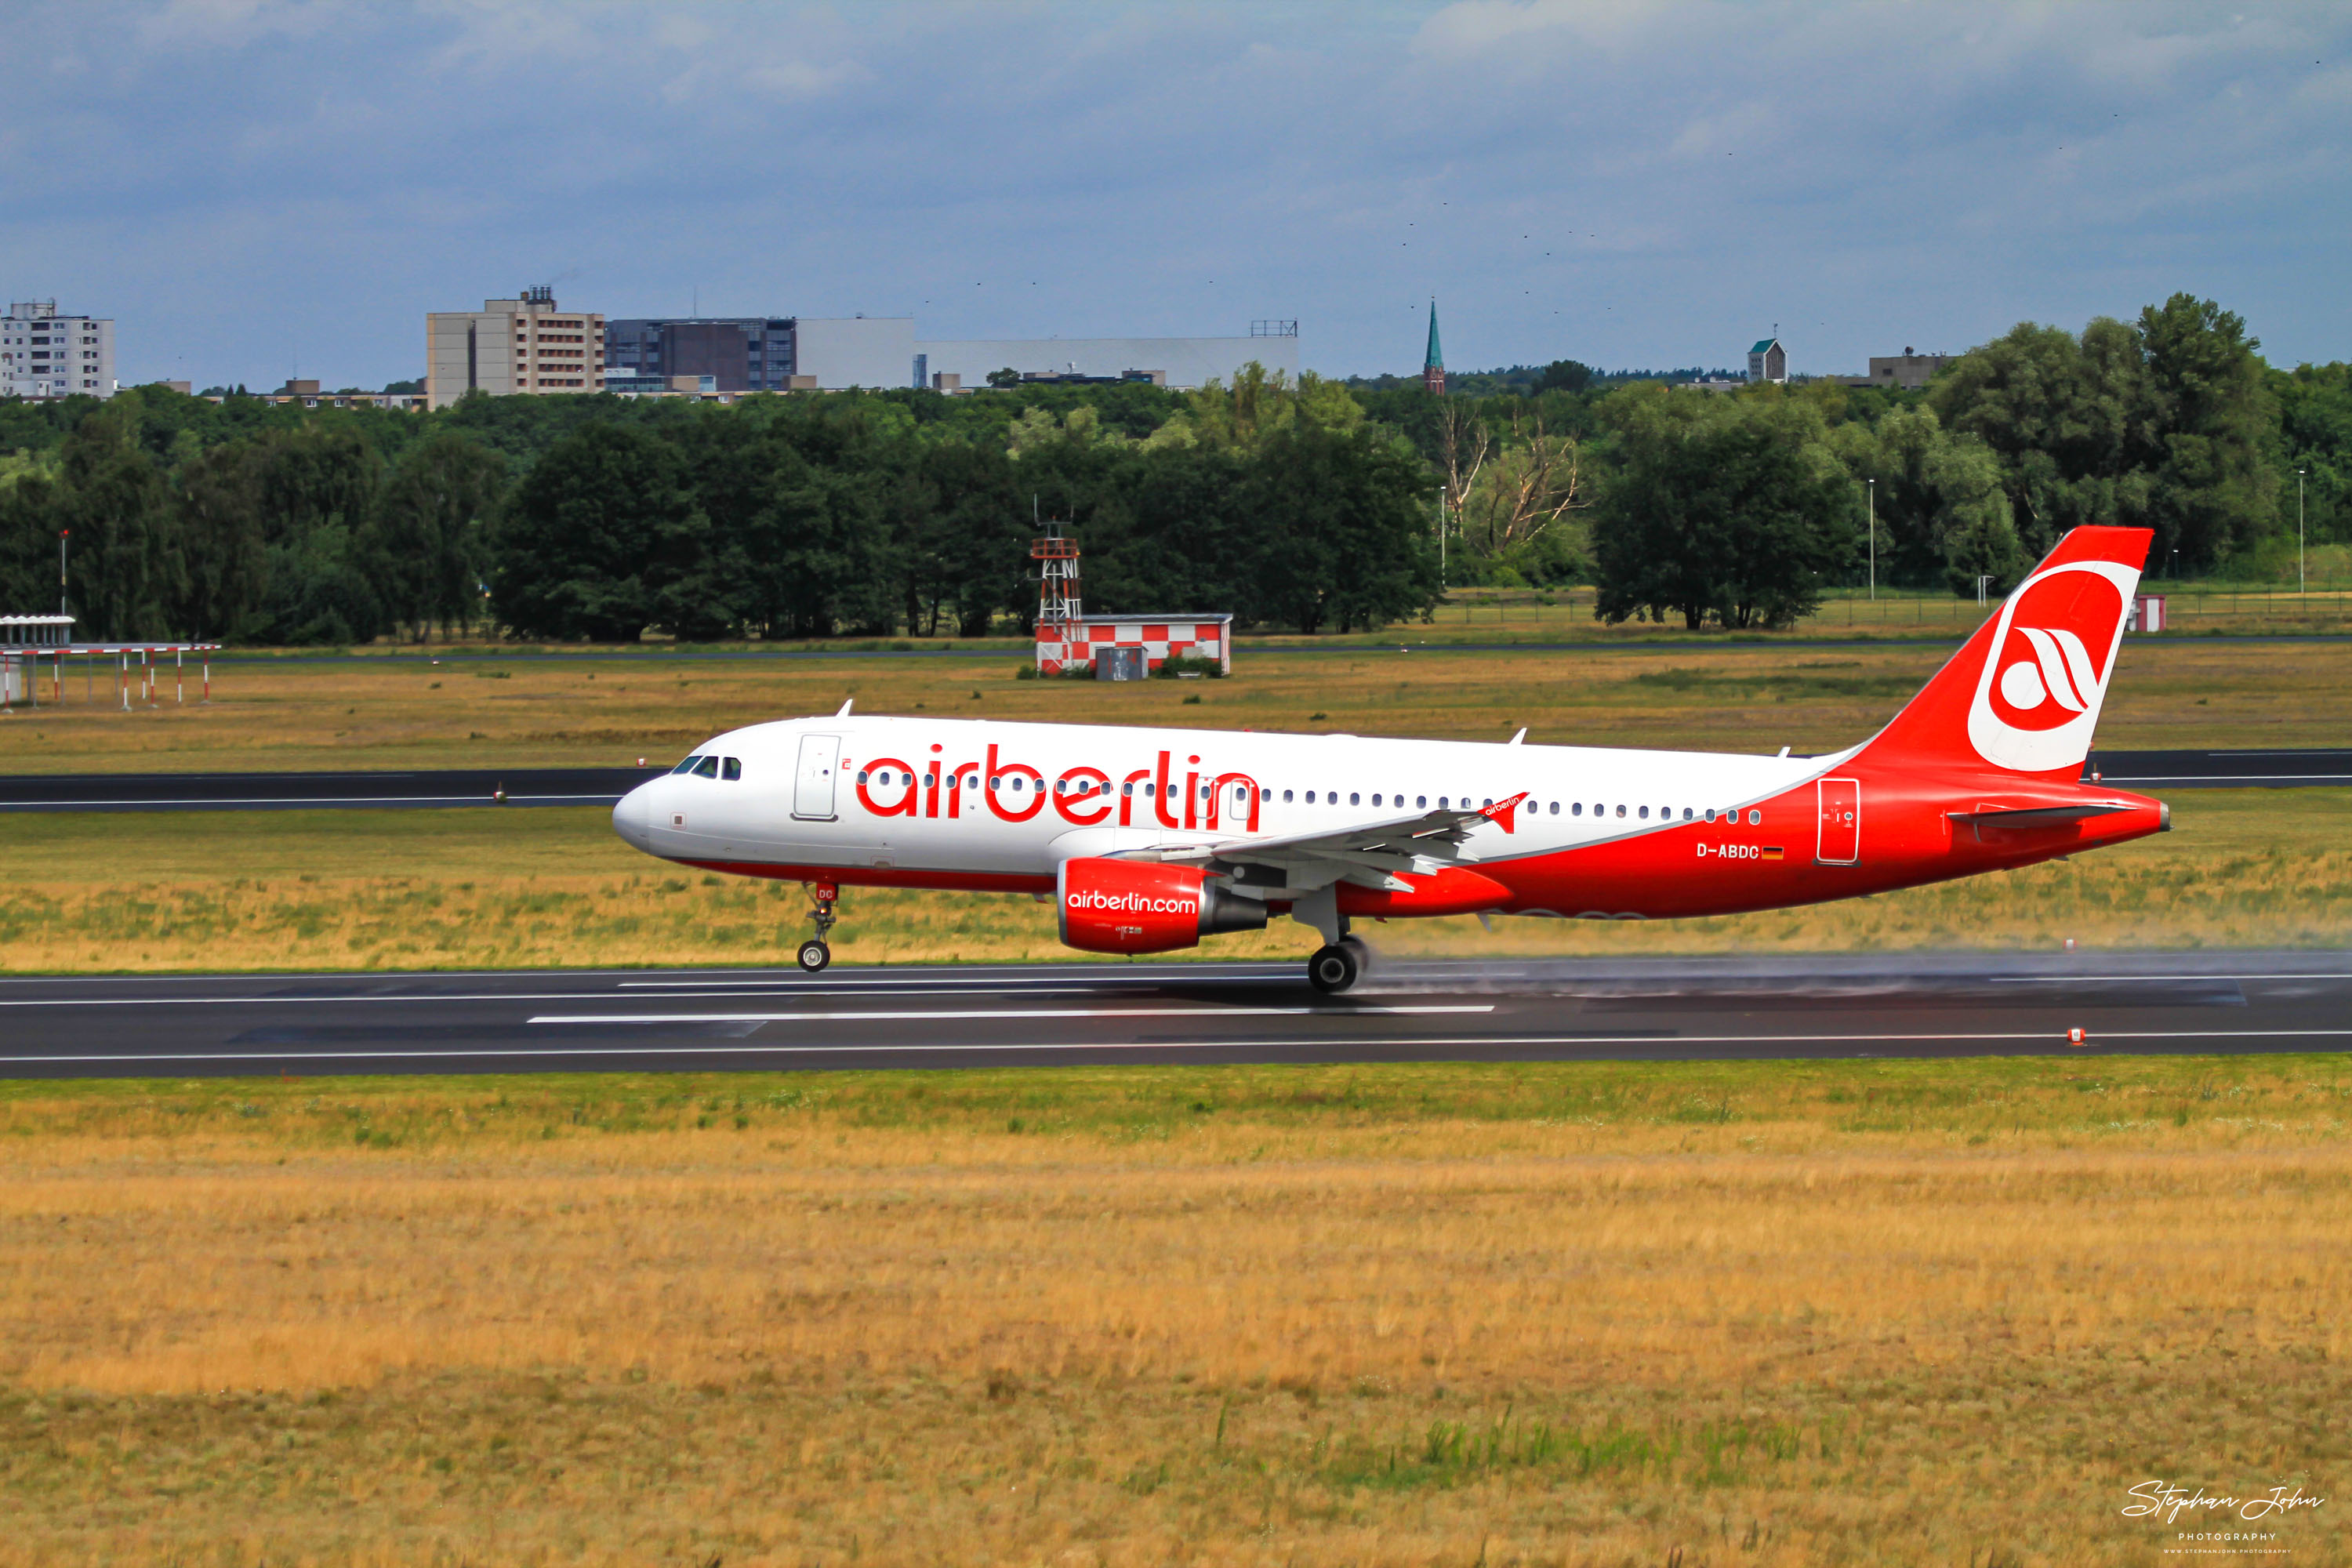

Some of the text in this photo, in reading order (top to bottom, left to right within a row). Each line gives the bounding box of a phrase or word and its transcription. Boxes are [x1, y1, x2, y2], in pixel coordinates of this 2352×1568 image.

[855, 743, 1260, 833] airberlin
[1485, 797, 1519, 816] airberlin
[1697, 843, 1759, 859] D-ABDC
[818, 890, 833, 899] DC
[1068, 890, 1196, 914] airberlin.com
